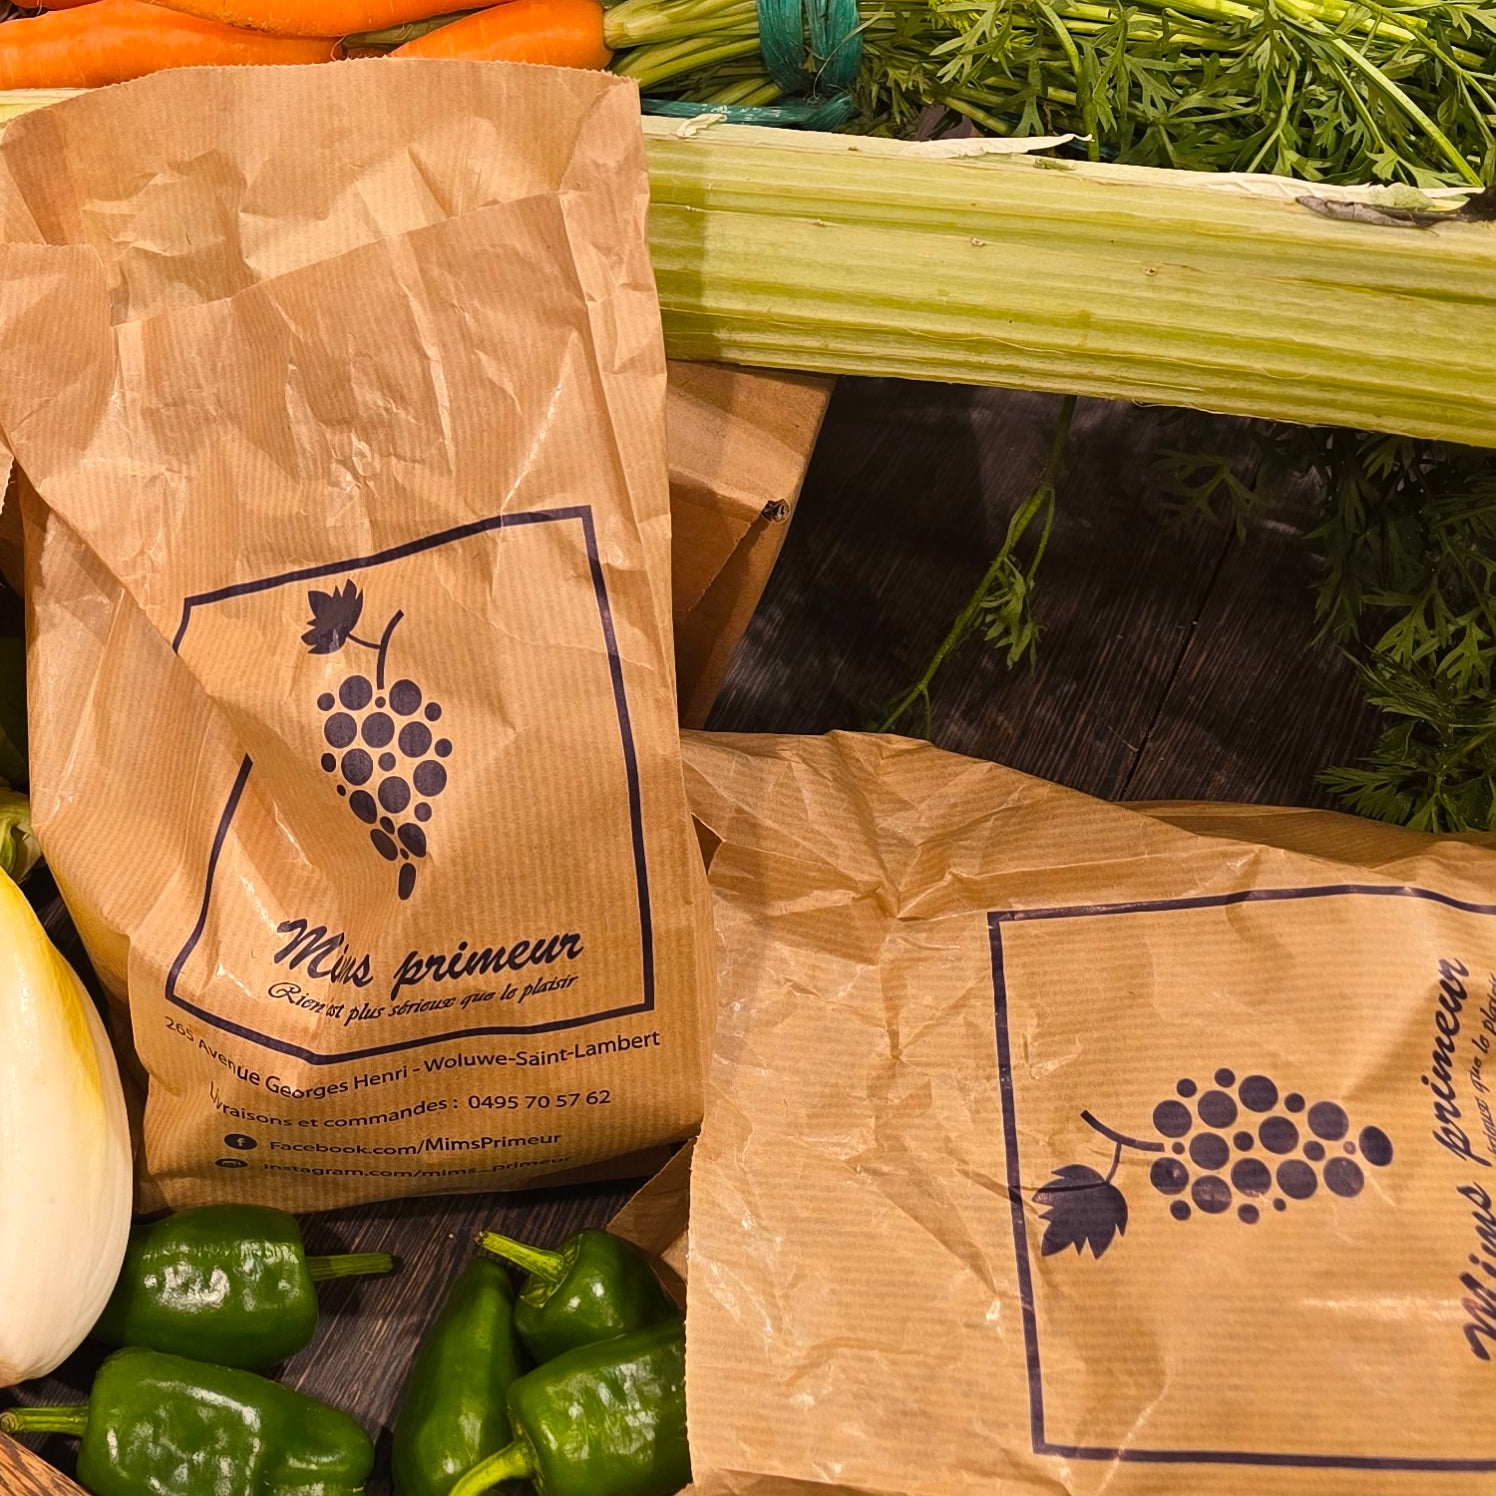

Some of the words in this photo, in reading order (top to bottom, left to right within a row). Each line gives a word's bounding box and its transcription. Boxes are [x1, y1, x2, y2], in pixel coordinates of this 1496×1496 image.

[390, 932, 584, 1001] primeur
[344, 1002, 385, 1026] plus
[388, 996, 456, 1018] sérieux
[460, 991, 495, 1009] que
[500, 983, 518, 1001] le
[518, 975, 578, 1004] plaisir
[165, 1016, 194, 1042] 265
[199, 1038, 261, 1086] Avenue
[266, 1075, 348, 1099] Georges
[354, 1064, 408, 1089] Henri
[424, 1031, 660, 1073] Woluwe-Saint-Lambert
[1420, 957, 1492, 1167] primeur
[298, 1118, 318, 1128] et
[324, 1098, 447, 1128] commandes
[468, 1095, 518, 1109] 0495
[525, 1095, 550, 1109] 70
[556, 1092, 581, 1107] 57
[586, 1090, 611, 1105] 62
[270, 1133, 562, 1155] Facebook.com/MimsPrimeur
